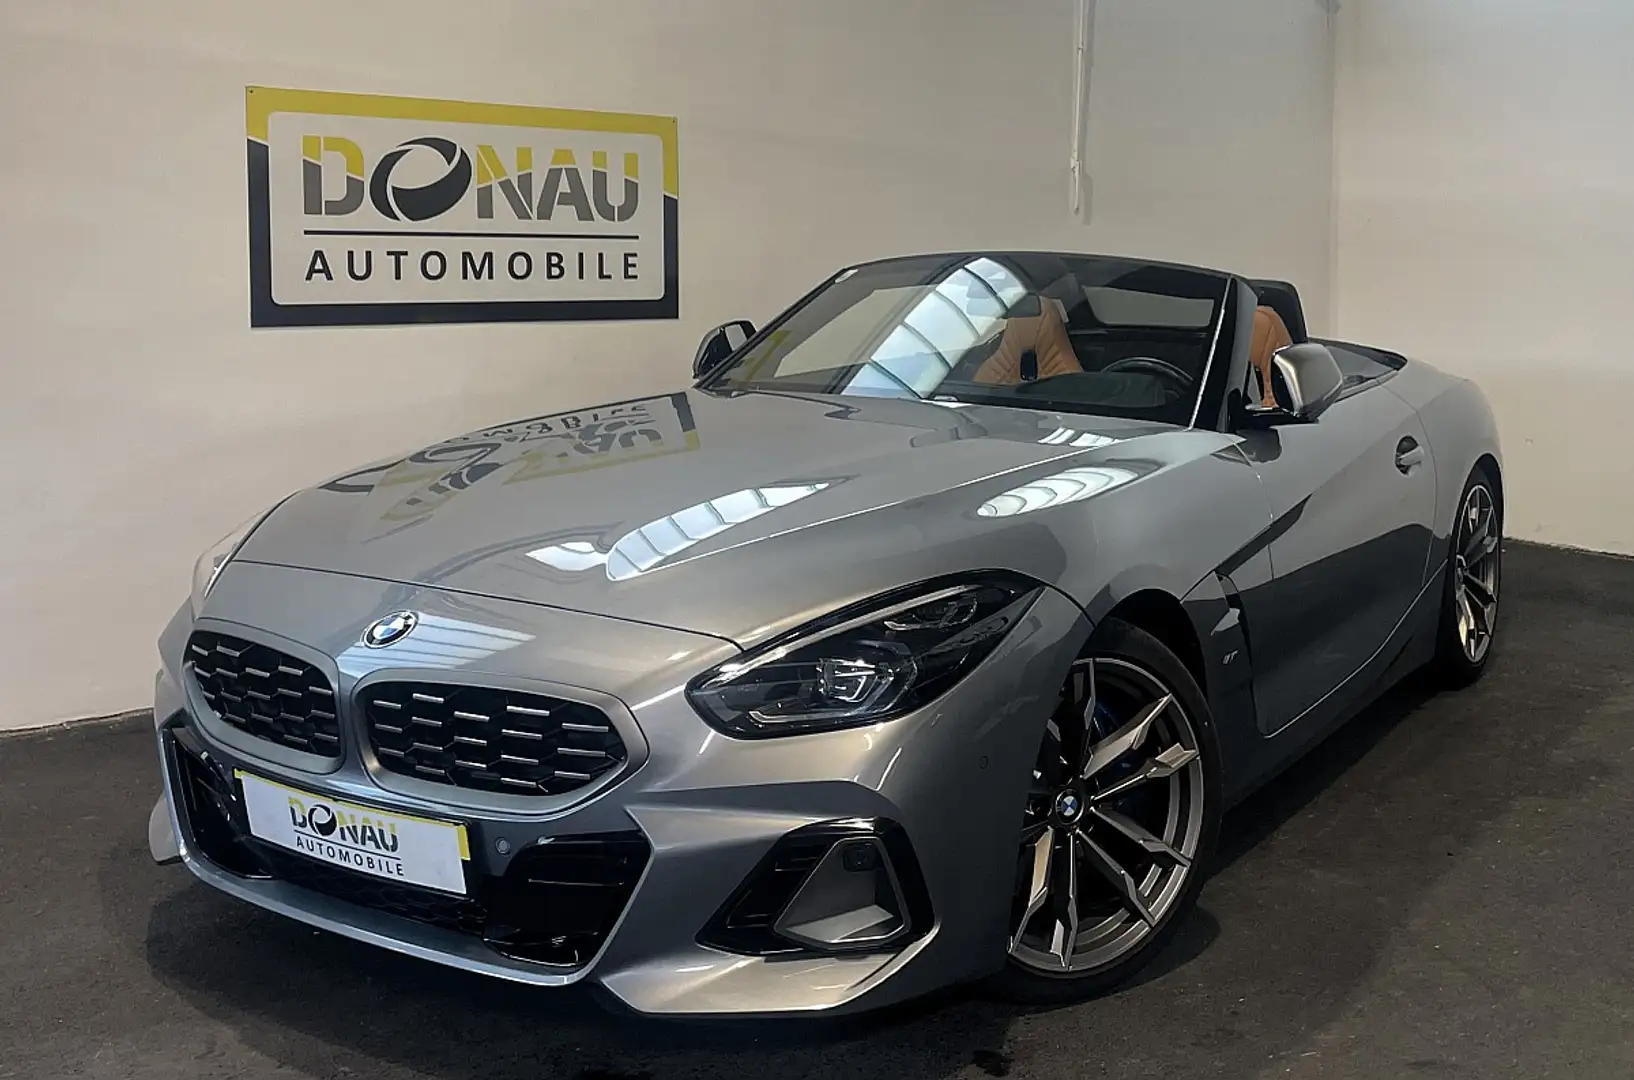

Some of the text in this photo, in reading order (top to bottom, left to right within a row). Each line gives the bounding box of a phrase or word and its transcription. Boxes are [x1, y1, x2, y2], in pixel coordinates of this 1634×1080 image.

[302, 135, 639, 222] DONAU
[305, 250, 639, 281] AUTOMOBILE
[288, 798, 399, 853] DONAU
[296, 836, 405, 877] AUTOMOBILE
